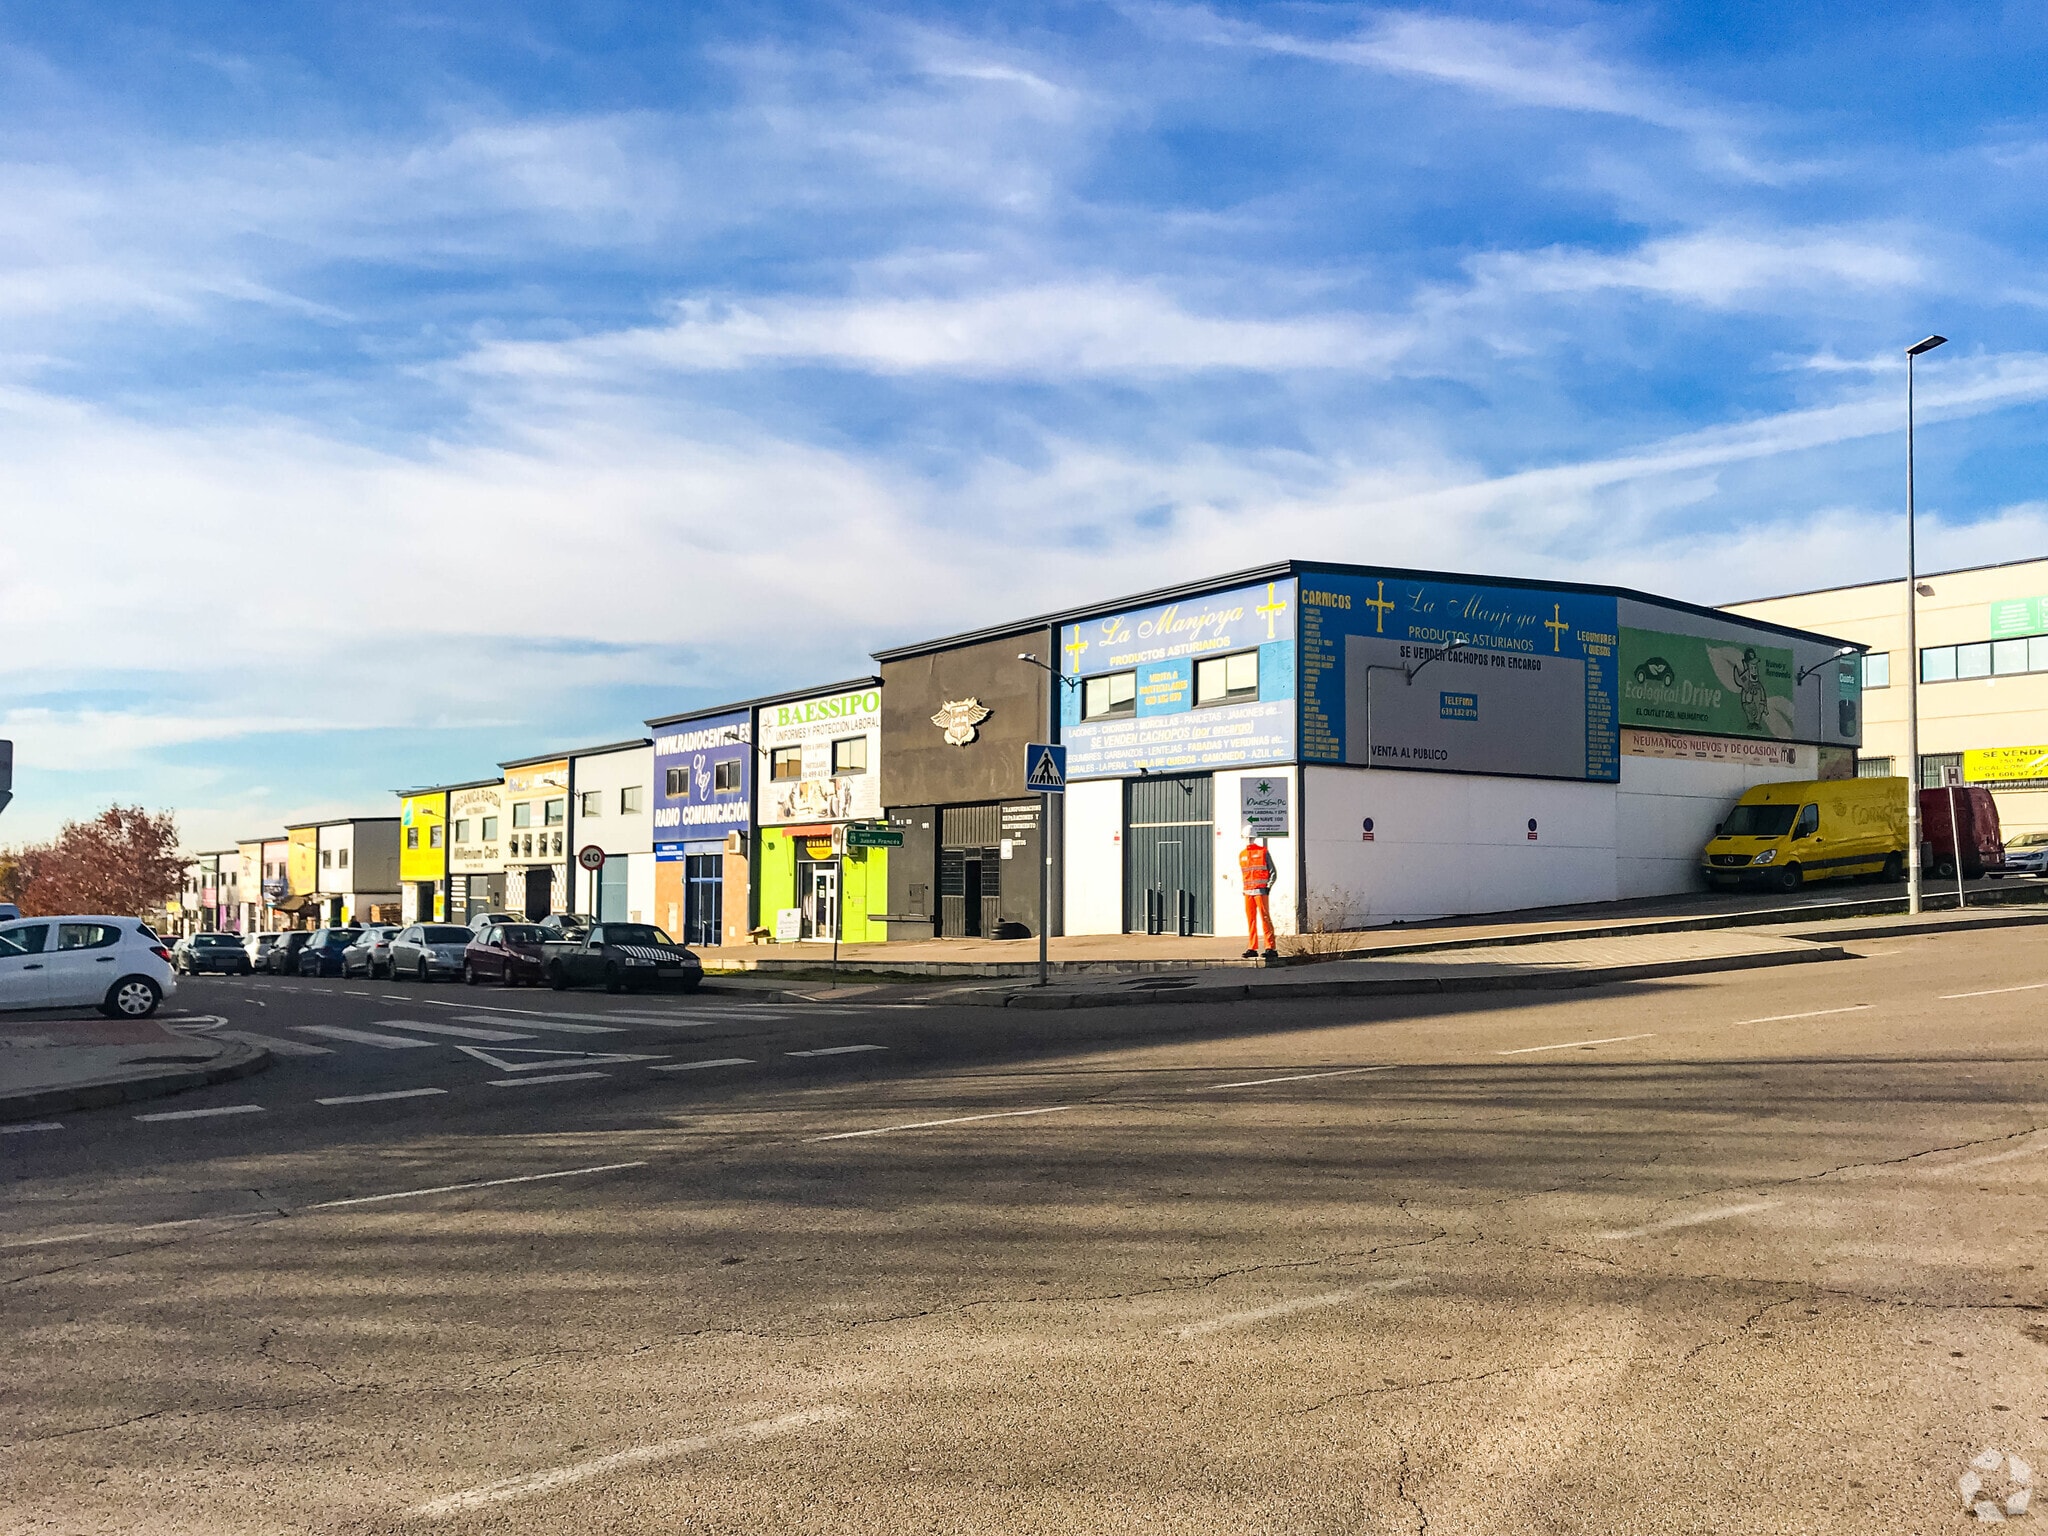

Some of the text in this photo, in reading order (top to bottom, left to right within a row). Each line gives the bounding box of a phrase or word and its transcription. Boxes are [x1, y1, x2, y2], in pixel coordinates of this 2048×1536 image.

[1099, 605, 1244, 647] La Manjoya
[1408, 625, 1534, 652] PRODUCTOS ASTURIANOS
[1110, 636, 1231, 667] PRODUCTOS ASTURIANOS
[1400, 645, 1412, 658] SE
[1448, 650, 1489, 667] CACHOPOS
[1490, 653, 1506, 668] POR
[1508, 655, 1542, 671] ENCARGO
[1625, 678, 1722, 708] Ecological Drive
[777, 691, 880, 727] BAESSIPO
[851, 716, 879, 731] LABORAL
[1090, 736, 1102, 748] SE
[1104, 733, 1136, 746] VENDEN
[1140, 727, 1189, 742] CACHOPOS
[1690, 741, 1722, 753] NUEVOS
[1723, 744, 1729, 753] Y
[1730, 744, 1741, 754] DE
[1371, 745, 1448, 761] VENTA AL PUBLICO
[2002, 749, 2045, 757] VENDE
[655, 807, 680, 828] RADIO
[583, 853, 601, 863] 40
